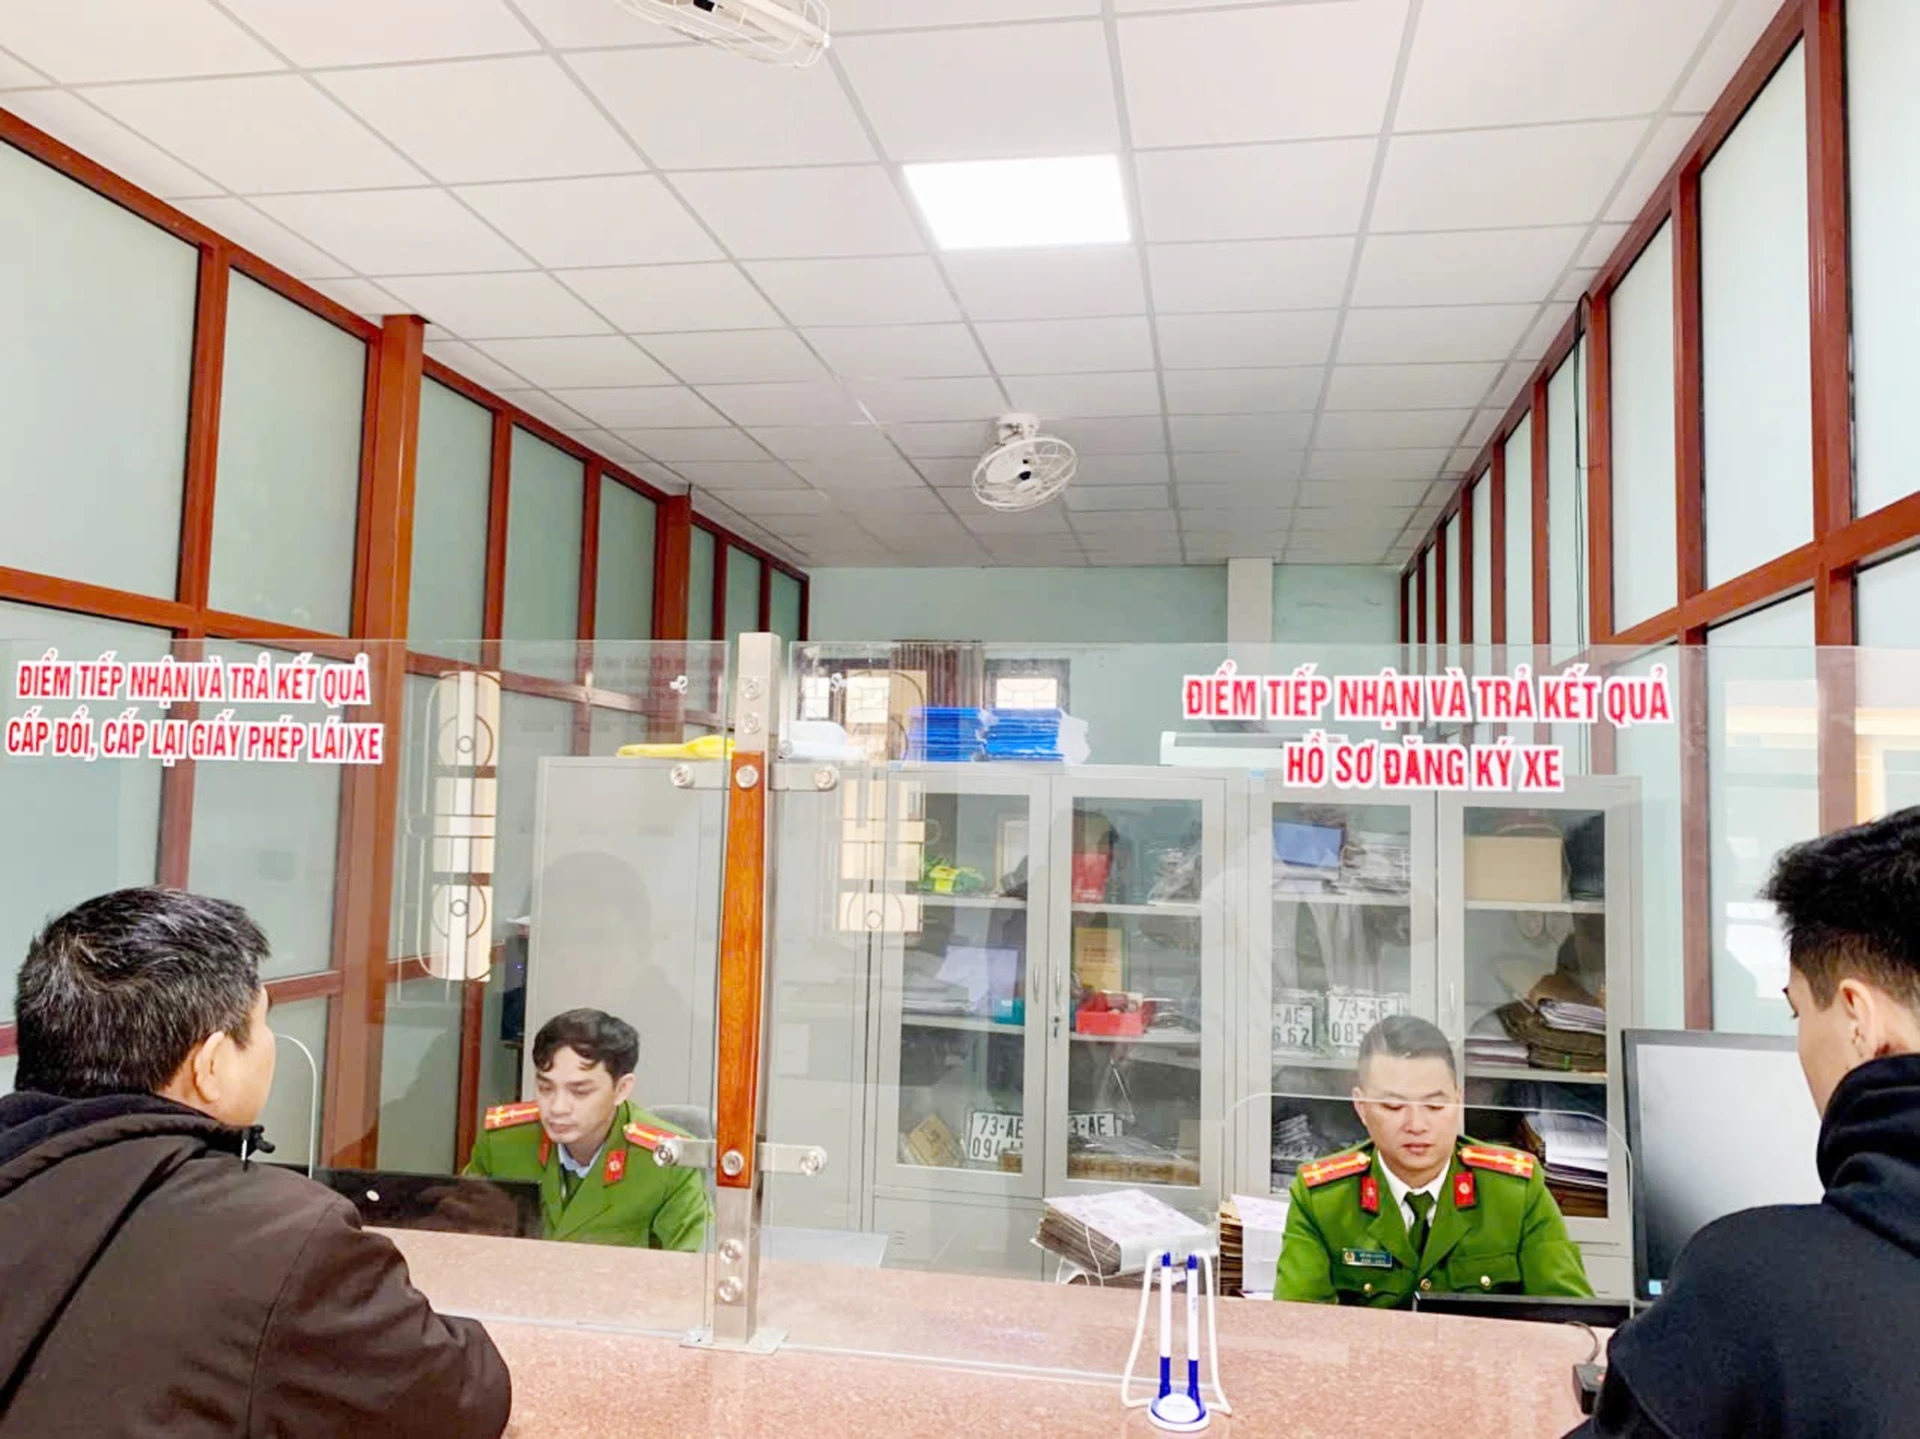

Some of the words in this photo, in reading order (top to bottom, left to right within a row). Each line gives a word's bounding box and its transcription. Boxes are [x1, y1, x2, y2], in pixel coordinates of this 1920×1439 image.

[18, 649, 73, 697] ĐIỂM
[78, 652, 125, 697] TIẾP
[129, 656, 190, 707] NHẬN
[197, 656, 223, 699] VÀ
[230, 654, 270, 700] TRẢ
[276, 654, 317, 701] KẾT
[323, 655, 367, 705] QUẢ
[1186, 660, 1257, 716] ĐIỂM
[1267, 665, 1328, 716] TIẾP
[1339, 670, 1421, 728] NHẬN
[1430, 669, 1468, 718] VÀ
[1476, 666, 1534, 719] TRẢ
[1542, 666, 1598, 720] KẾT
[1607, 666, 1670, 724] QUẢ
[7, 707, 50, 753] CẤP
[54, 706, 96, 759] ĐỔI,
[102, 708, 147, 755] CẤP
[151, 723, 185, 764] LẠI
[190, 710, 240, 758] GIẤY
[248, 717, 304, 759] PHÉP
[312, 717, 345, 760] LÁI
[353, 727, 380, 760] XE
[1287, 731, 1325, 784] HỒ
[1335, 741, 1376, 784] SƠ
[1382, 738, 1465, 787] ĐĂNG
[1476, 739, 1512, 787] KÝ
[1523, 749, 1562, 788] XE
